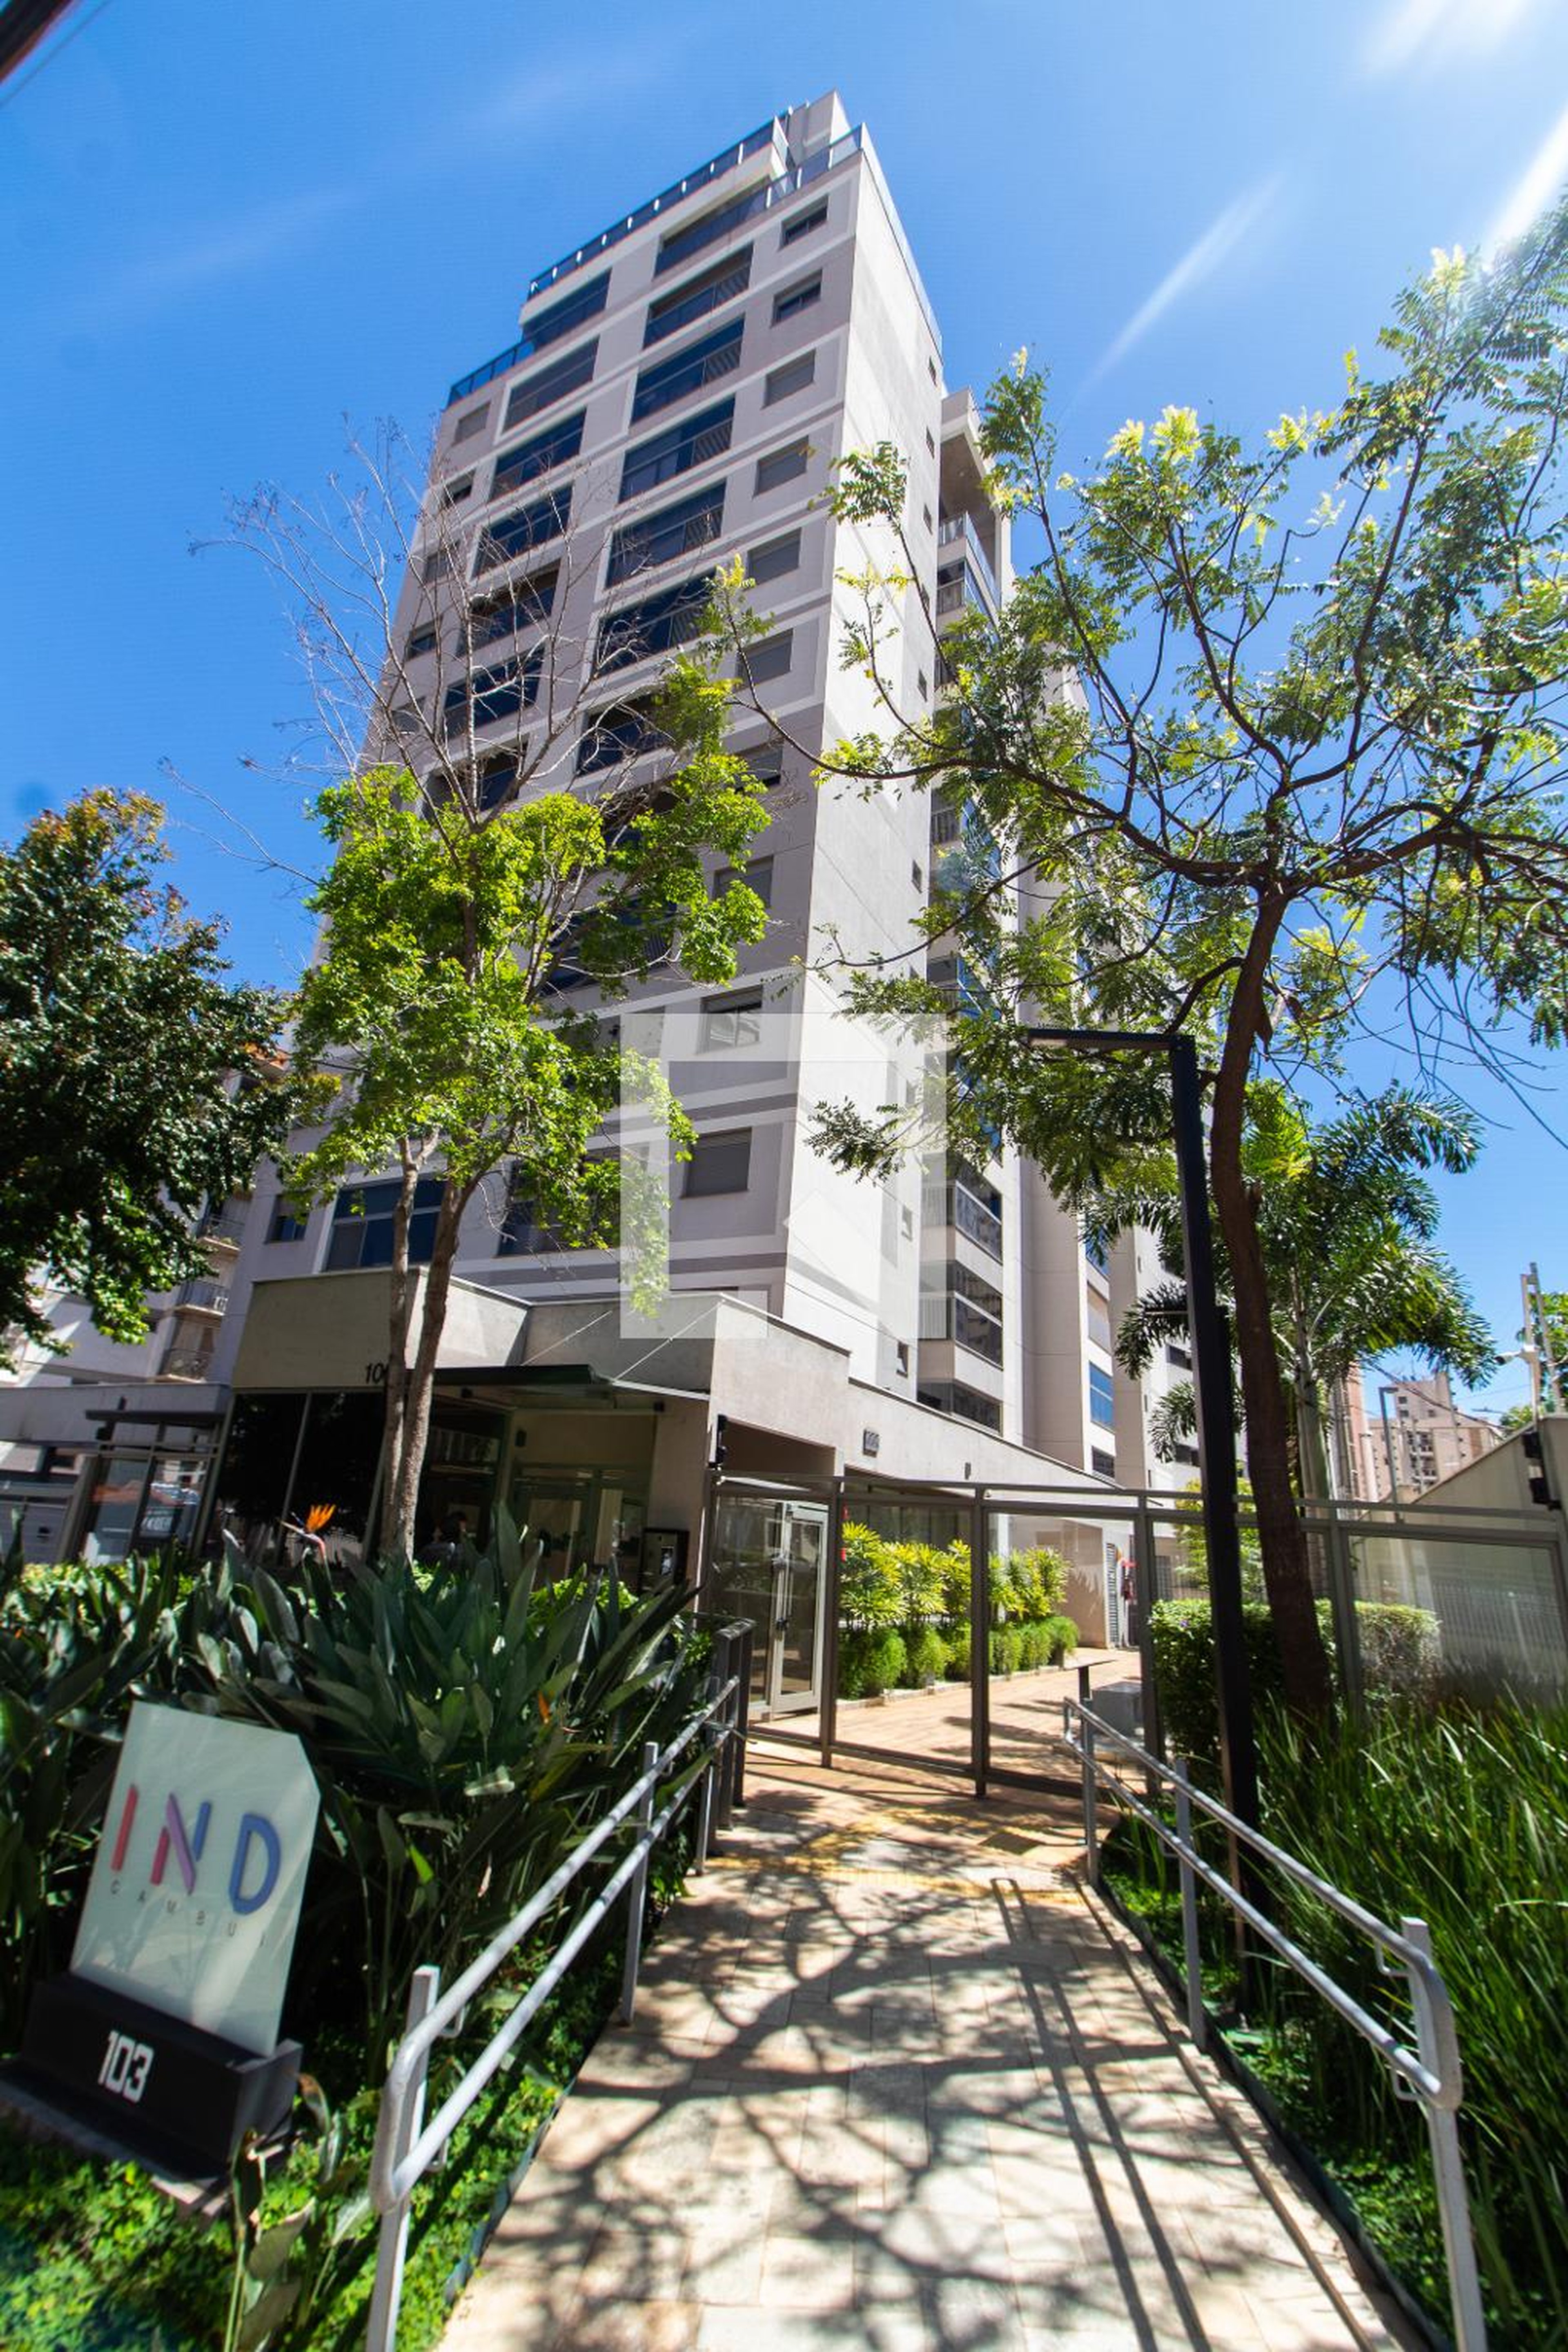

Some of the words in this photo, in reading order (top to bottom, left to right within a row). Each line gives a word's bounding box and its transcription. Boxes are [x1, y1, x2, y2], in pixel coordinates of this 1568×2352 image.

[365, 1363, 389, 1384] 10
[110, 1785, 281, 1915] IND
[98, 2030, 154, 2103] 103
